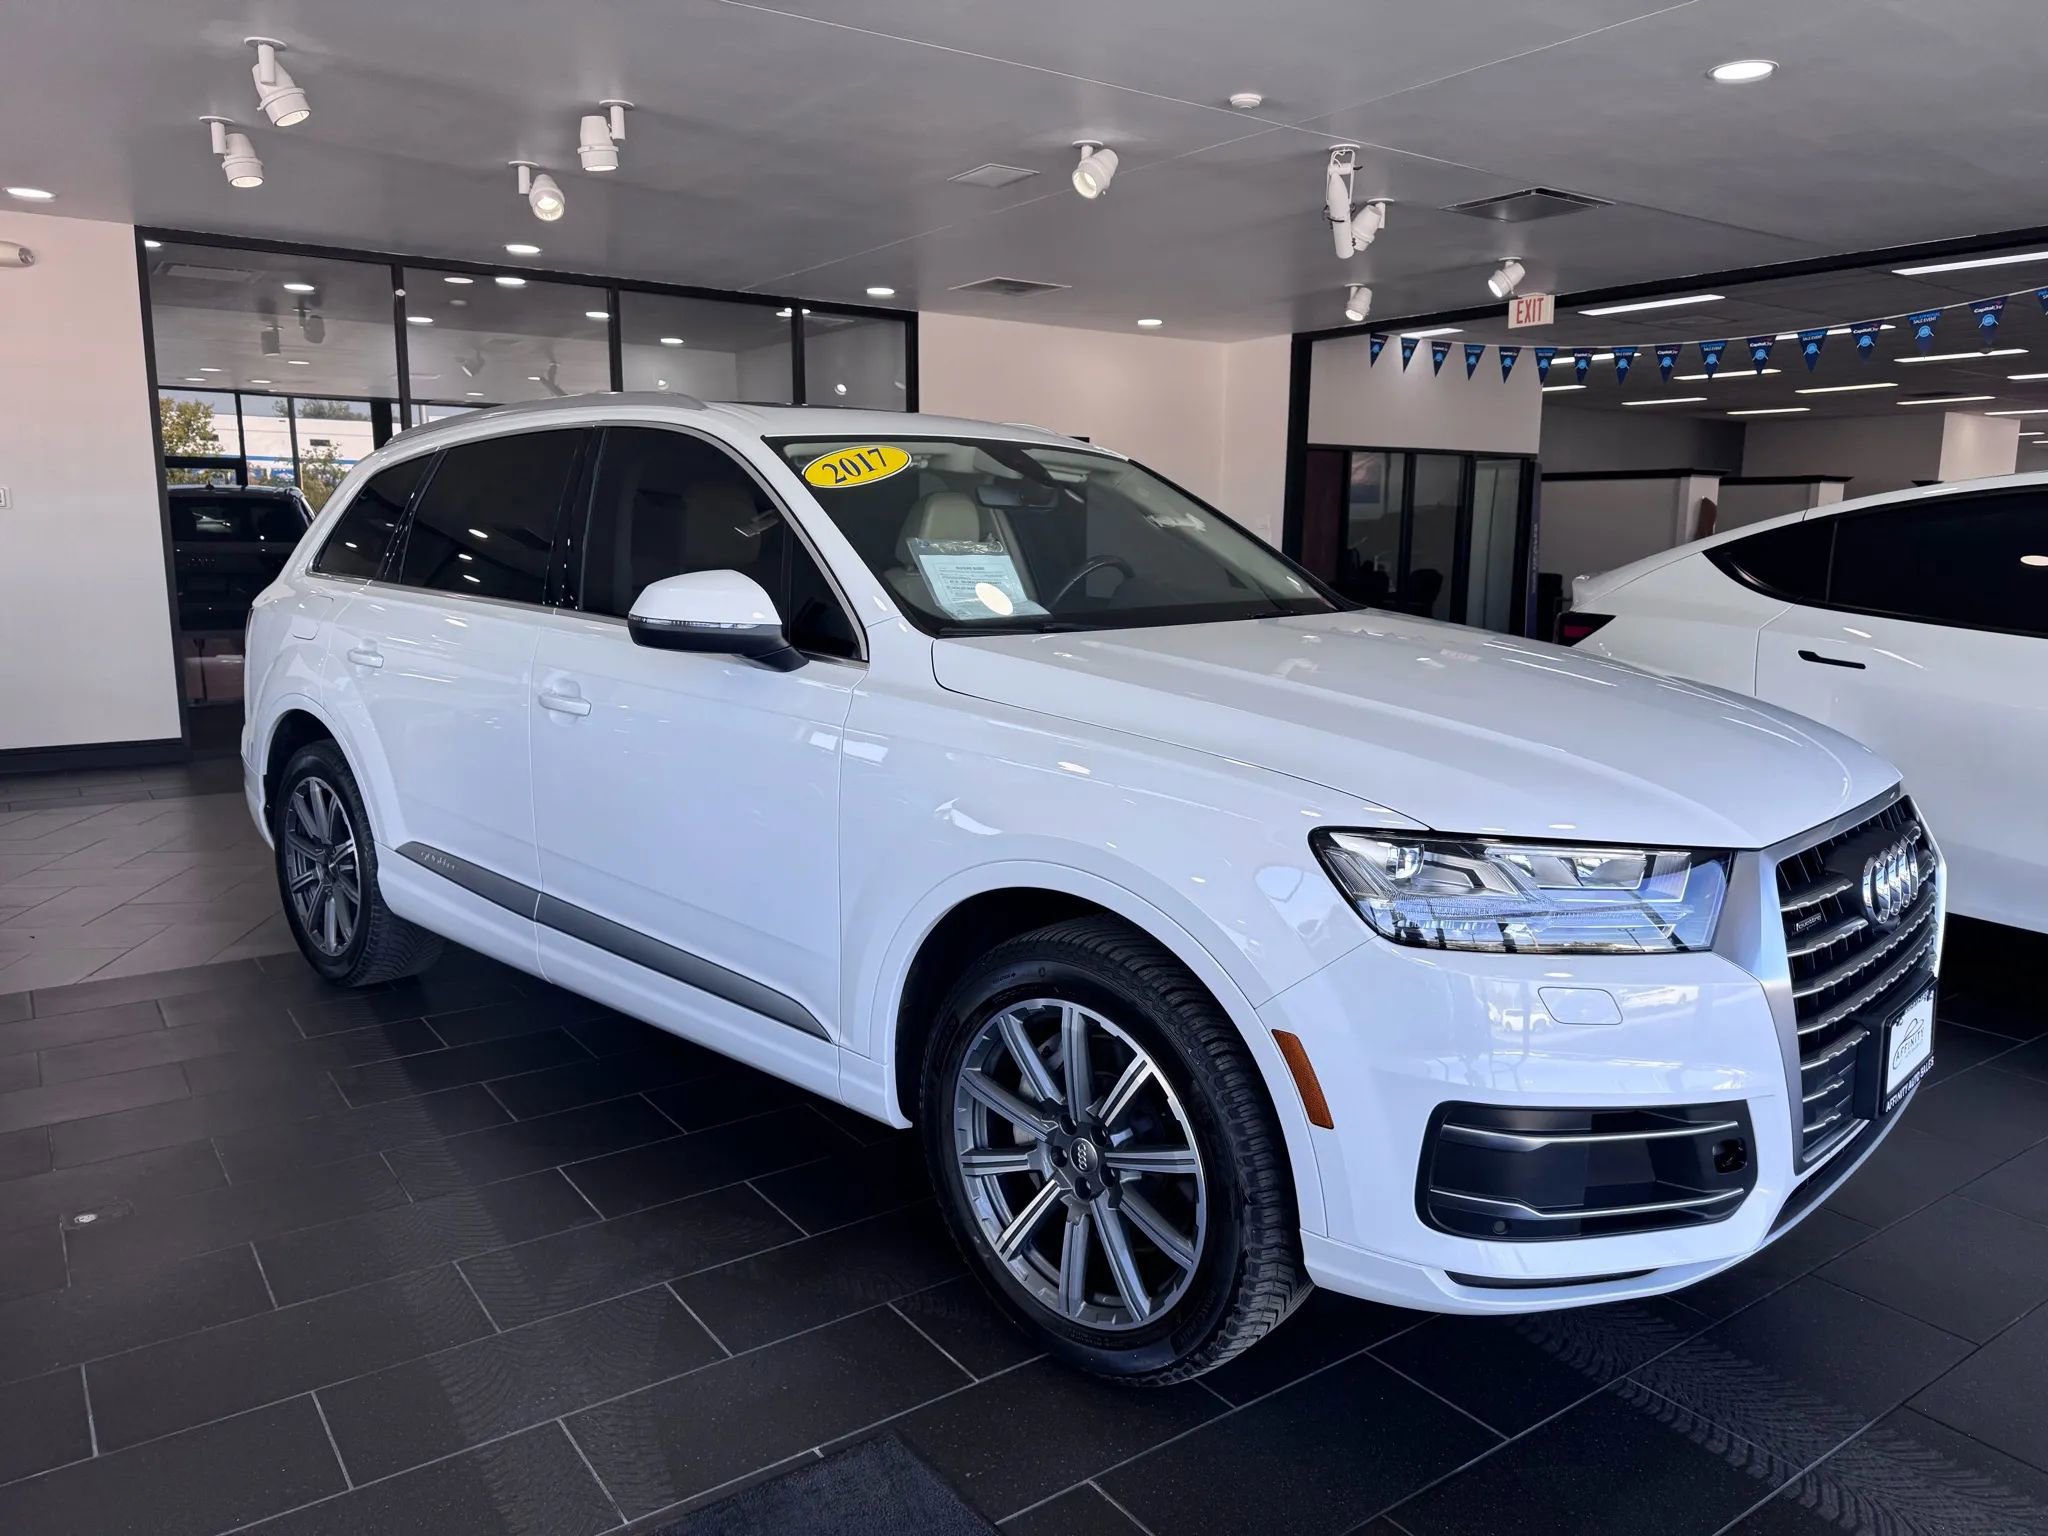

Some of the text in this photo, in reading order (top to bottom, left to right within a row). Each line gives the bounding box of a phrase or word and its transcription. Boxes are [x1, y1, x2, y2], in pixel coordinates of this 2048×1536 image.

[1516, 297, 1544, 324] EXIT
[822, 447, 887, 484] 2017
[1885, 1082, 1909, 1113] AFFINITY
[1919, 1055, 1935, 1079] SALES
